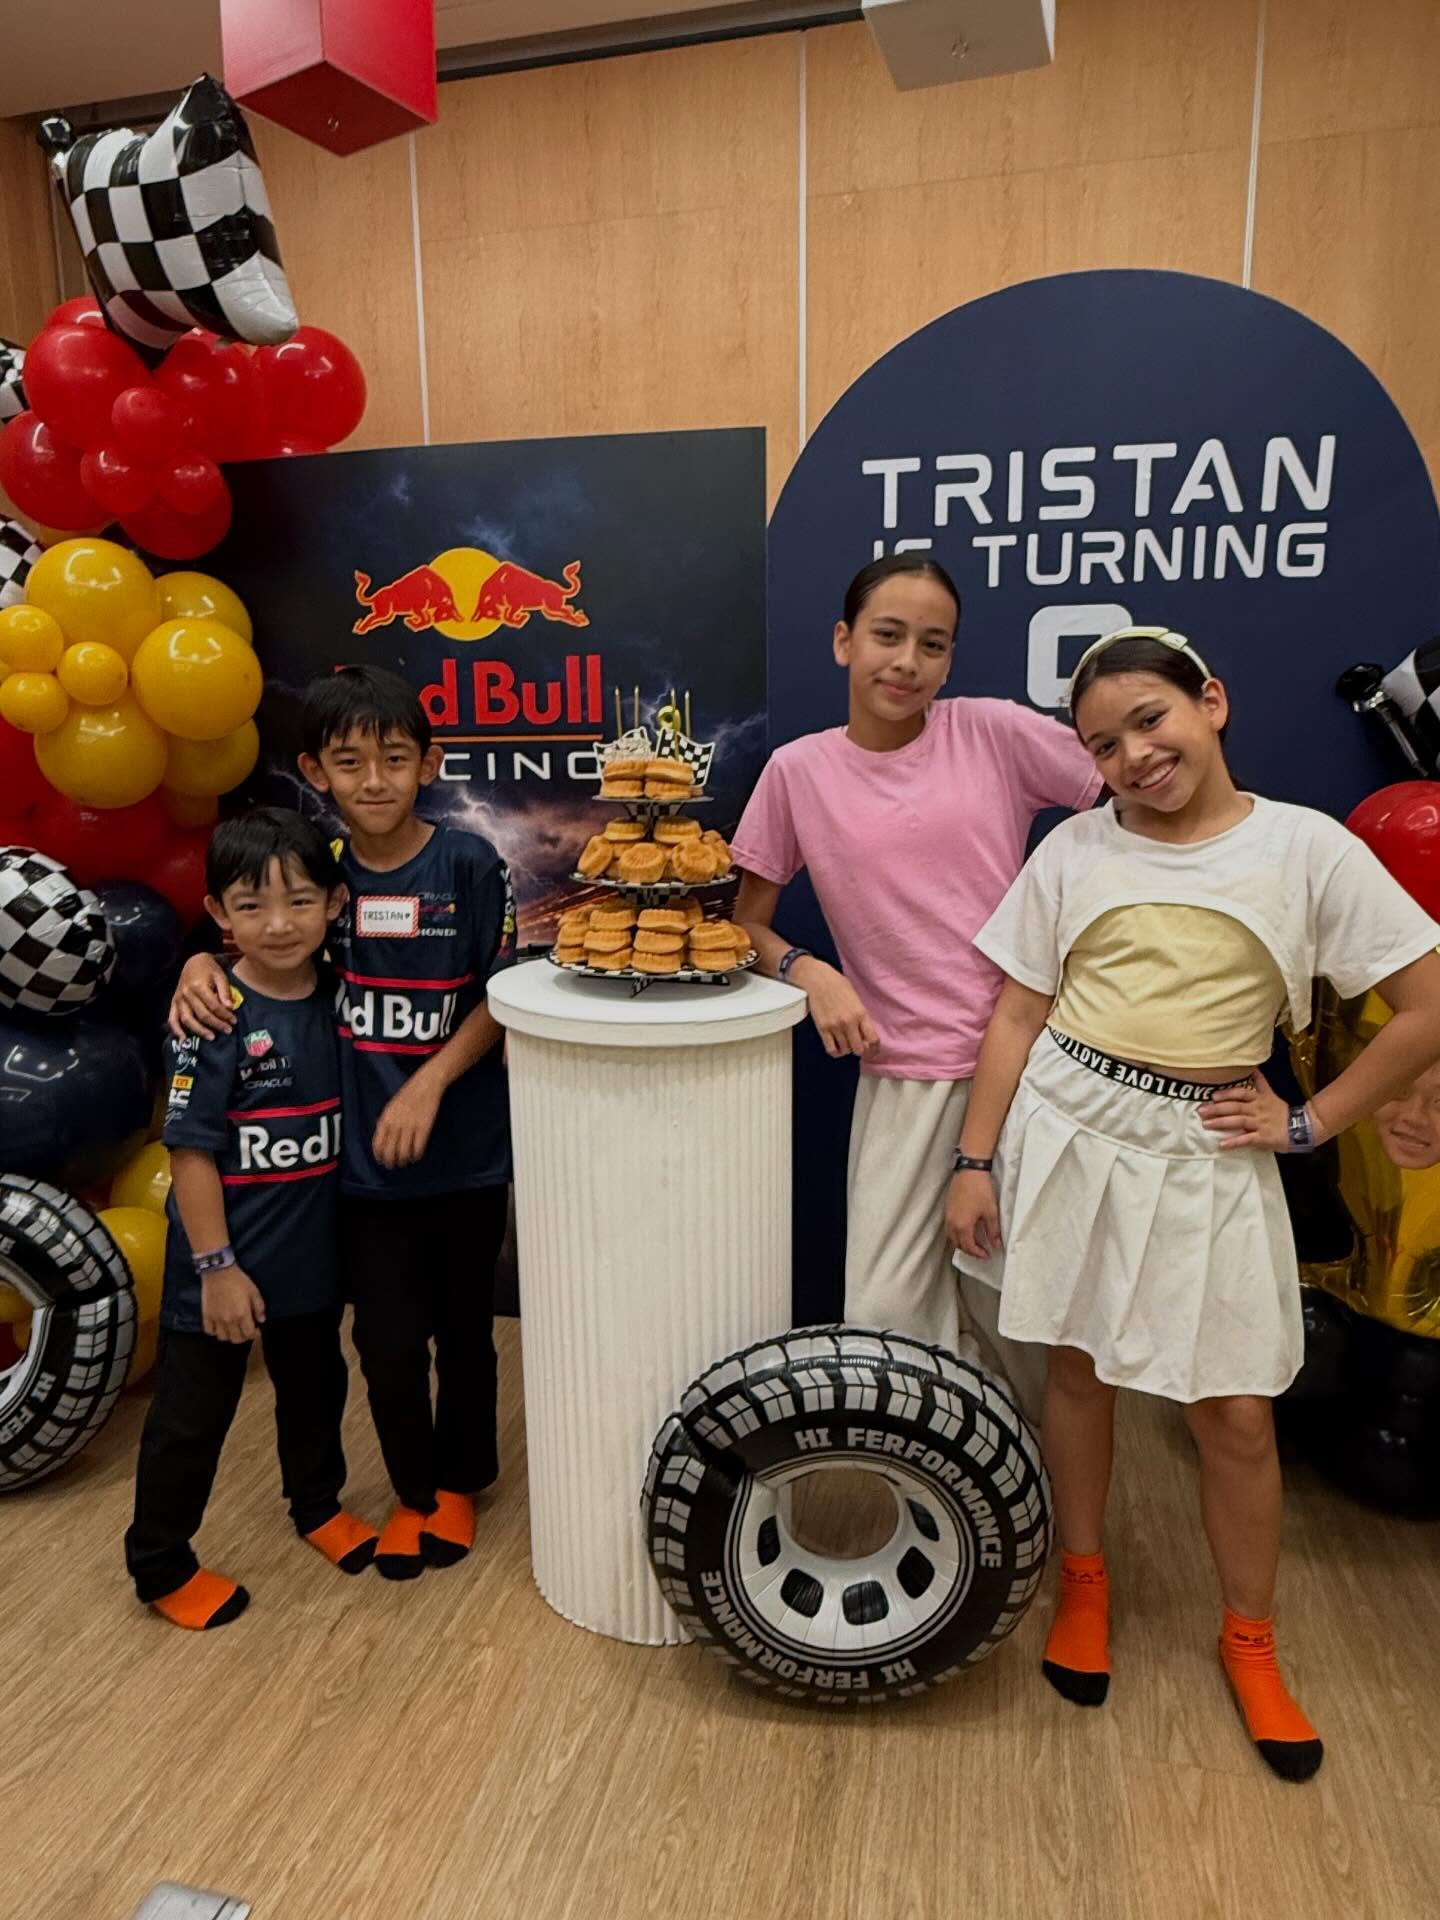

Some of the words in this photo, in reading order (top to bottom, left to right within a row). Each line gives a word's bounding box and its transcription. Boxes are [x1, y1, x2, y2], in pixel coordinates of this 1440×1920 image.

[862, 435, 1336, 528] TRISTAN
[972, 522, 1329, 588] TURNING
[473, 655, 602, 725] Bull
[438, 751, 600, 781] CING
[363, 911, 404, 921] TRISTAN
[383, 992, 457, 1041] Bull
[1071, 1042, 1112, 1075] LOVE
[1114, 1064, 1165, 1093] LOVE
[1167, 1081, 1212, 1100] LOVE
[239, 1115, 328, 1170] Red
[795, 1426, 832, 1451] HI
[882, 1659, 917, 1684] HI
